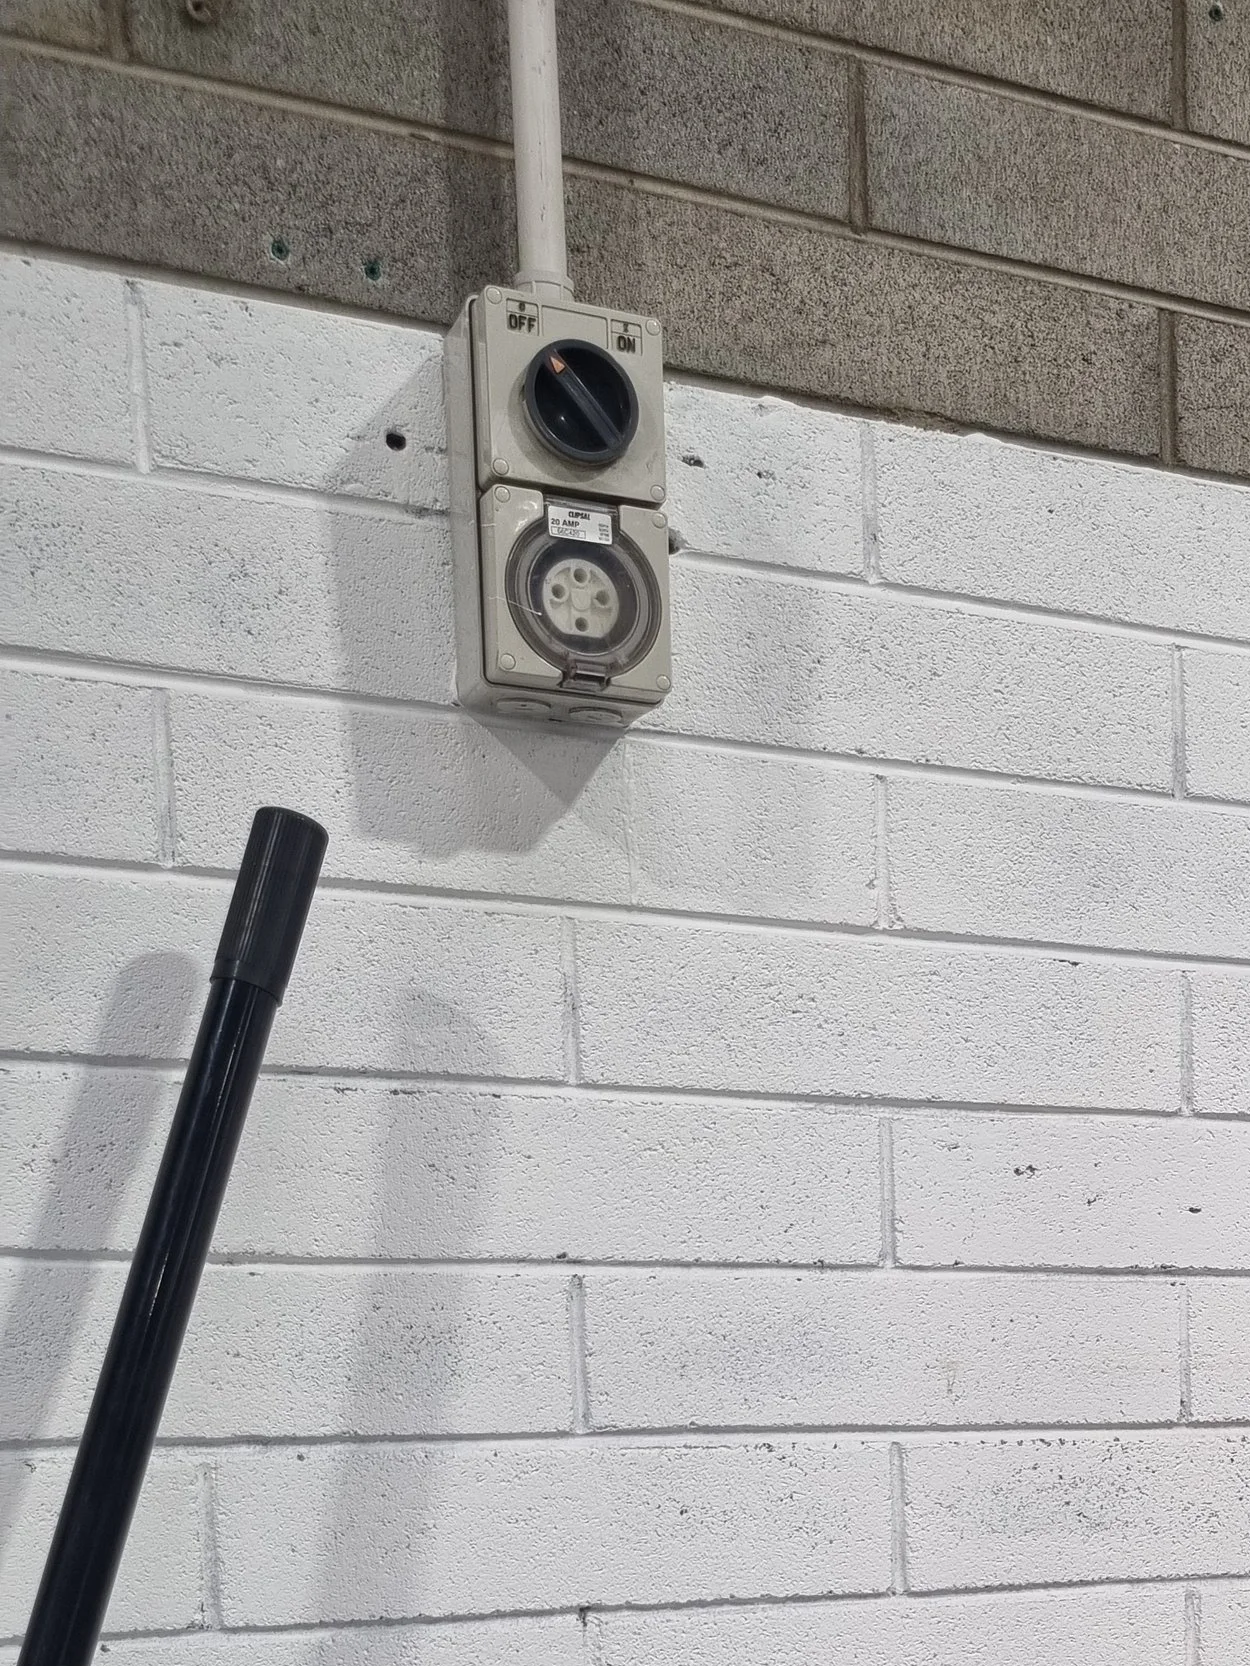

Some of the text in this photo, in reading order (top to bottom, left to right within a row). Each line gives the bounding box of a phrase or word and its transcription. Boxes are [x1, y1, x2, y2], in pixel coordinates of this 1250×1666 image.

[508, 313, 537, 333] OFF
[616, 335, 636, 353] ON
[550, 517, 580, 528] 20 AMP
[568, 511, 591, 521] CLIPSAL
